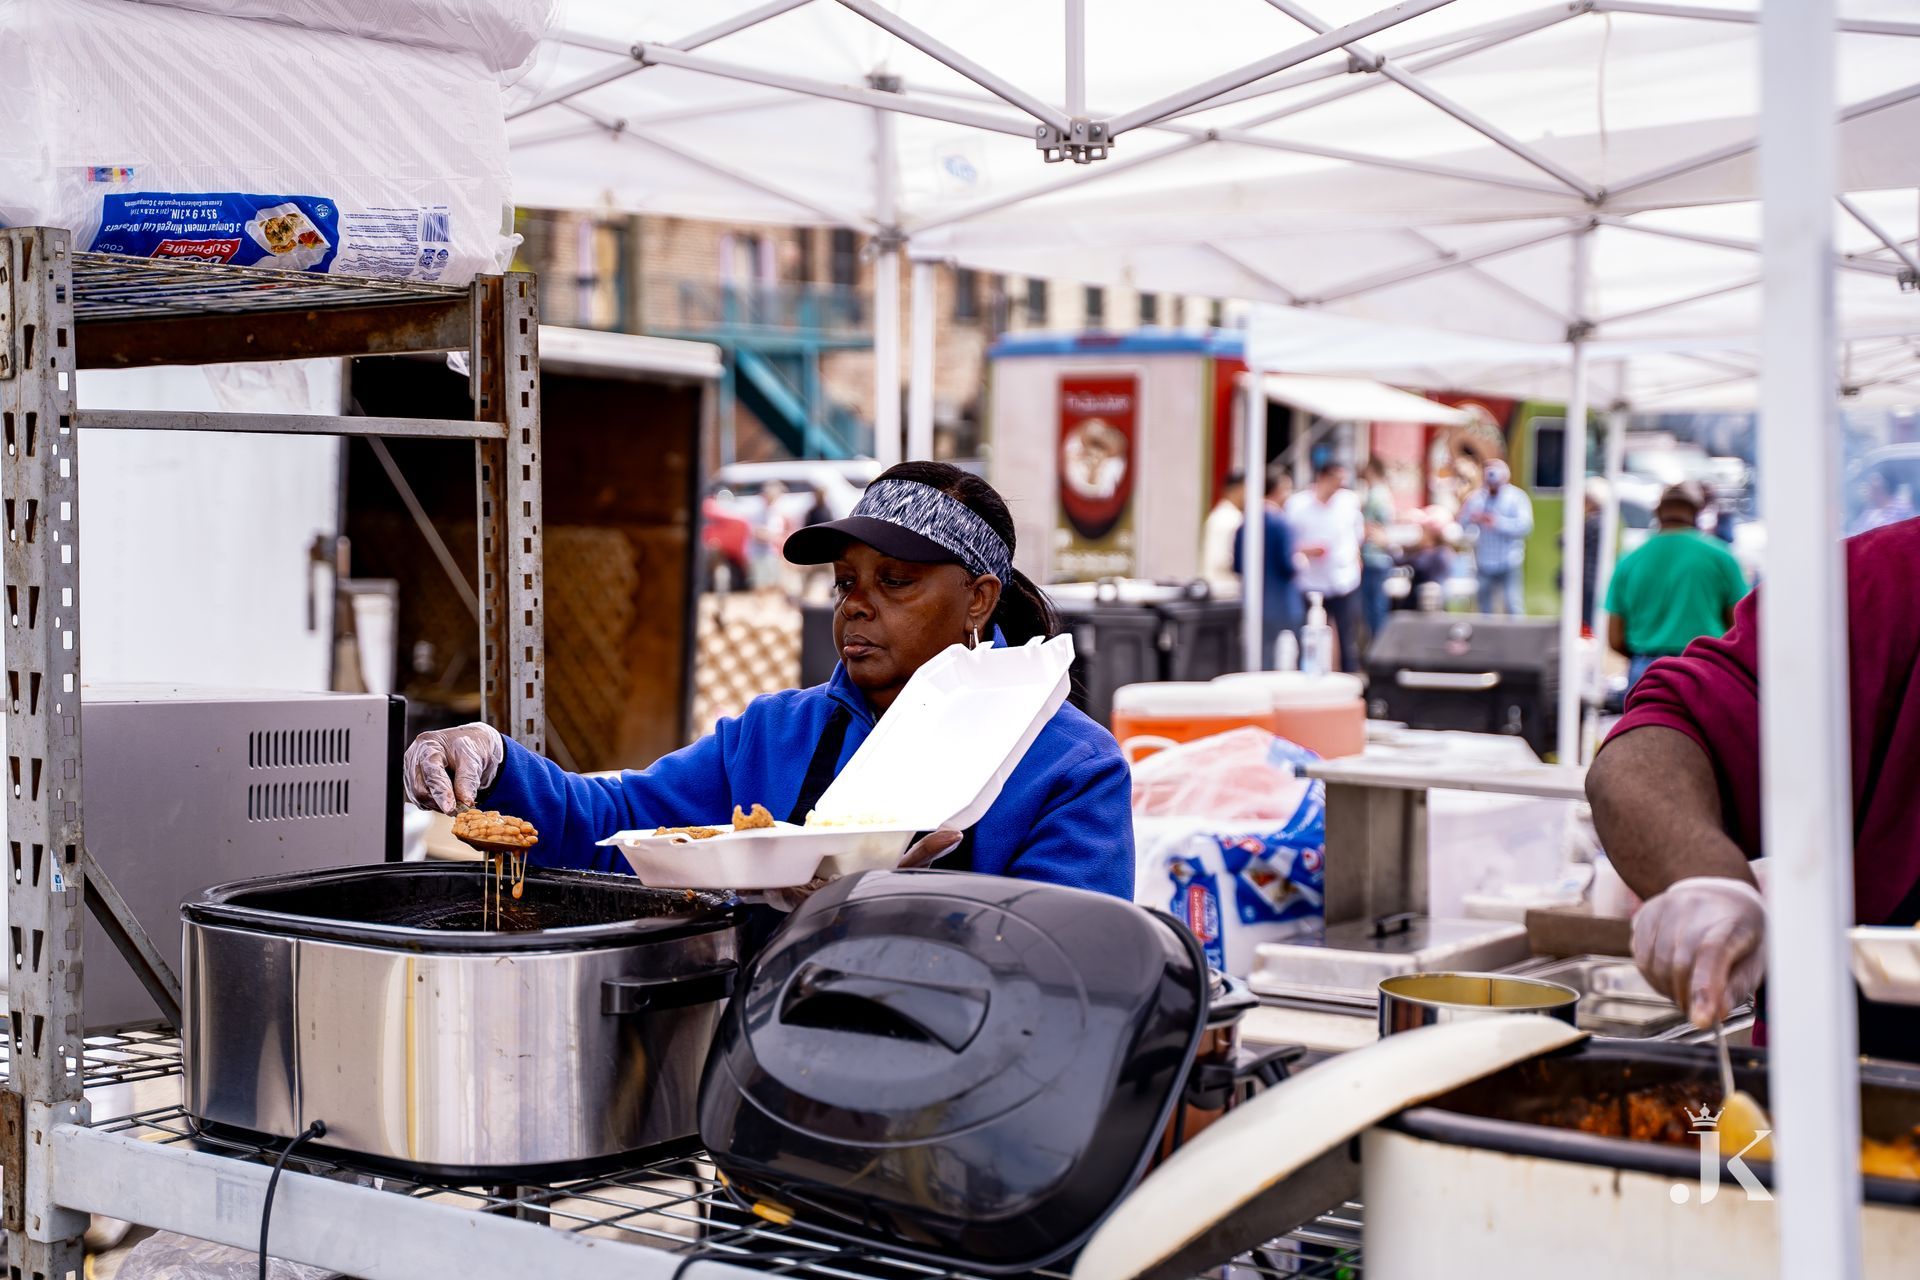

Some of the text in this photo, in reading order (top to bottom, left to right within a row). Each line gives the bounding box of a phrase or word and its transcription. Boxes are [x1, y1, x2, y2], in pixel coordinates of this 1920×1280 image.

[180, 208, 185, 219] 3
[192, 209, 199, 220] 9
[200, 209, 206, 218] x
[206, 208, 217, 220] 9.5
[142, 222, 157, 232] Lid
[155, 221, 183, 234] Hinged
[184, 221, 235, 233] Compartment
[235, 223, 241, 232] 3
[163, 243, 232, 254] SUPREME
